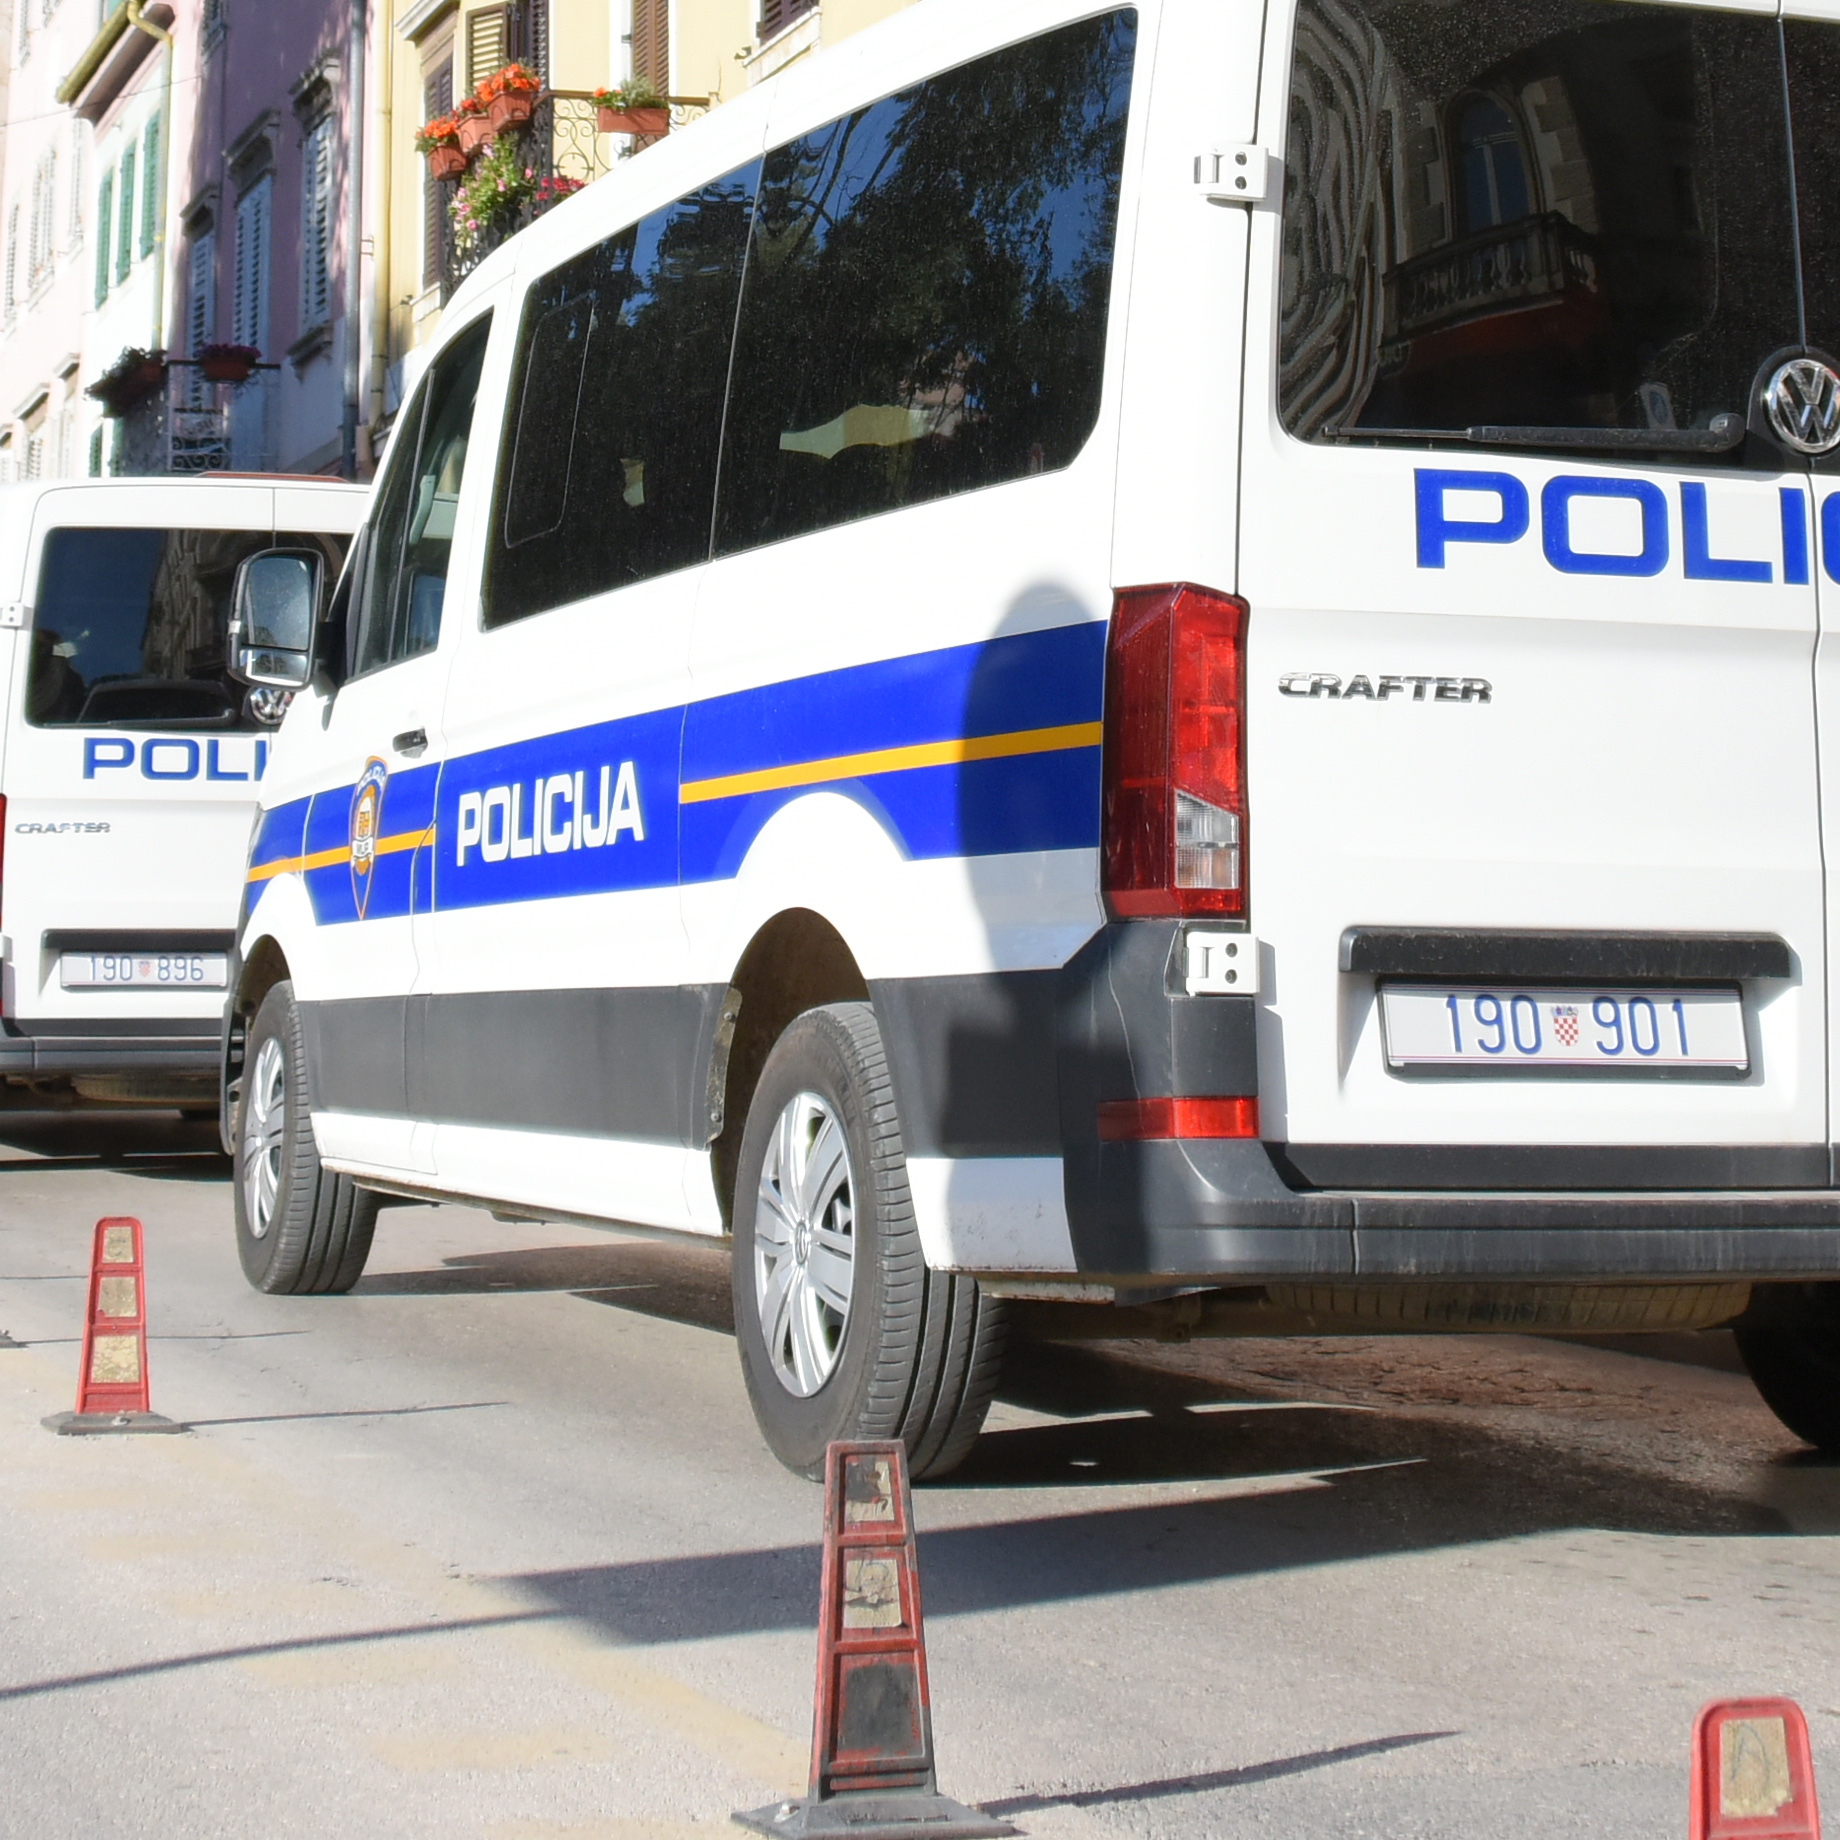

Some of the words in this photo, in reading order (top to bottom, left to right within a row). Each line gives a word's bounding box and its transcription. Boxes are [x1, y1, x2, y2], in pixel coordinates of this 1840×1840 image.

[1277, 672, 1493, 704] CRAFTER
[82, 737, 267, 782] POLI
[15, 822, 111, 834] CRAFTER
[456, 760, 645, 867] POLICIJA
[89, 956, 133, 981] 190
[157, 956, 204, 981] 896
[1445, 994, 1542, 1055] 190
[1591, 996, 1689, 1057] 901
